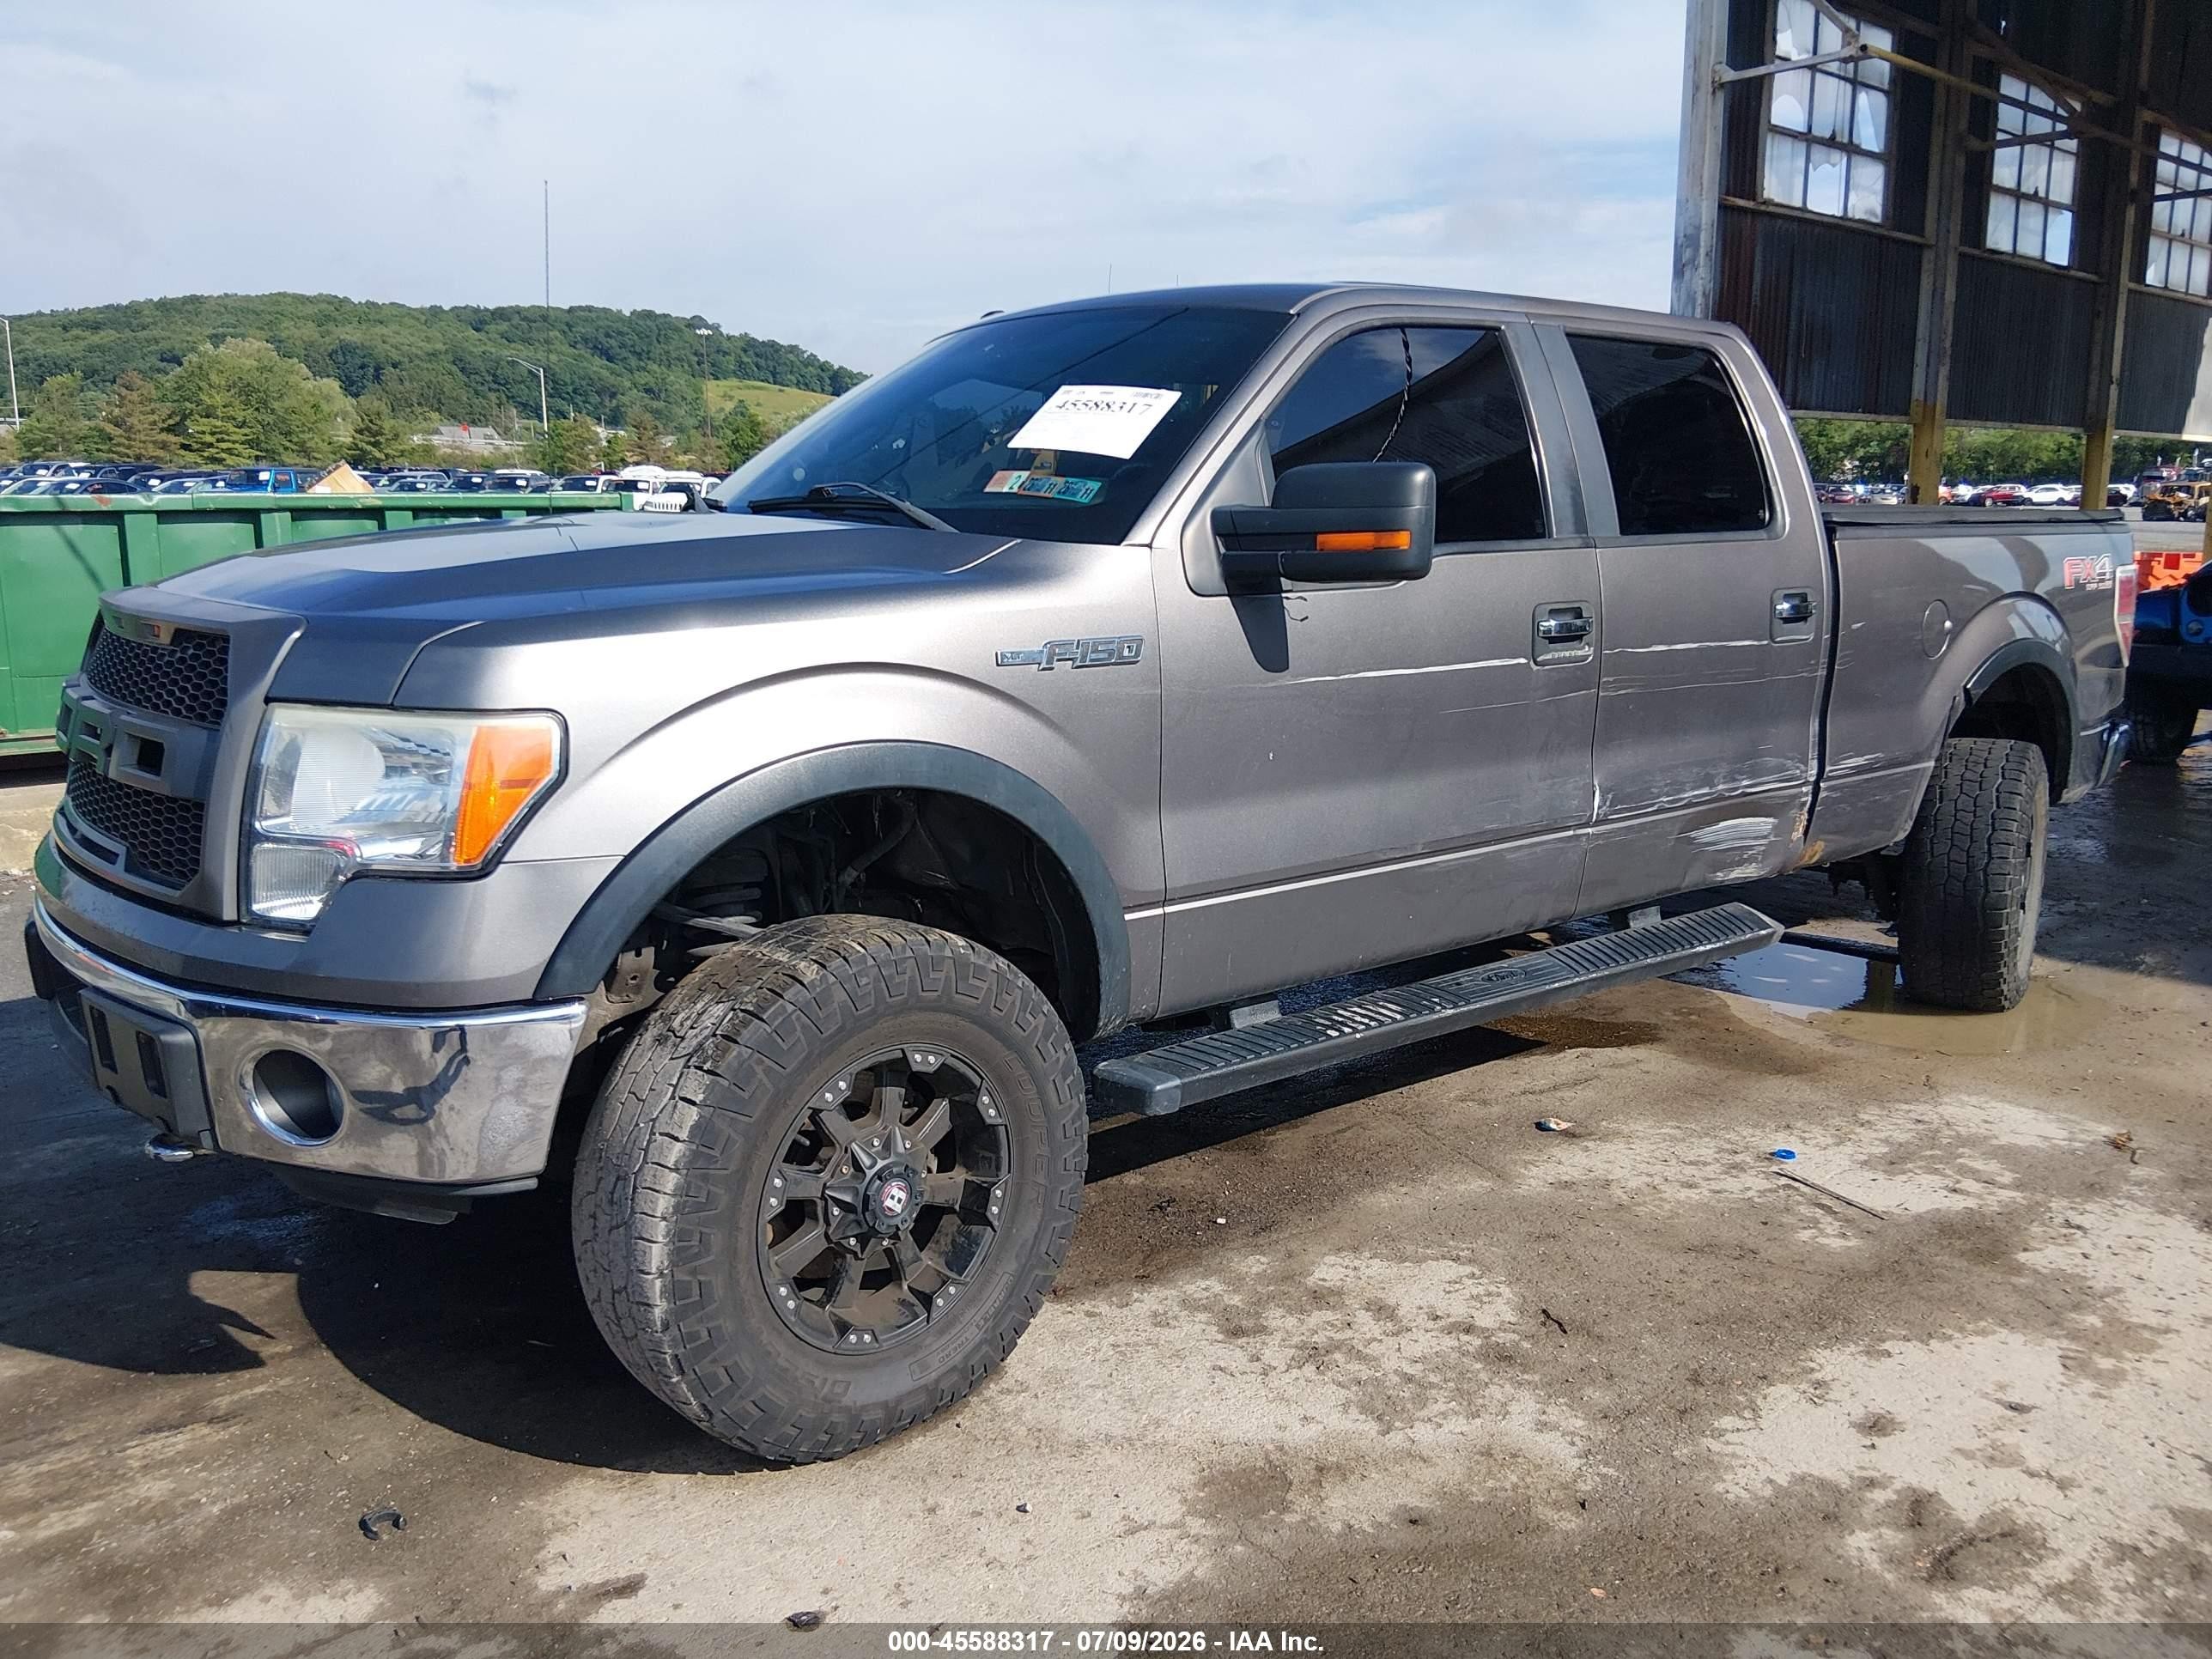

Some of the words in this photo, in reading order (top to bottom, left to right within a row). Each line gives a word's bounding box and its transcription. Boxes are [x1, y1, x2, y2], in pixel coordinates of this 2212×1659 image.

[1055, 398, 1152, 416] 45588317
[2063, 553, 2113, 590] FX4
[1037, 634, 1145, 672] F-150
[1003, 1050, 1050, 1212] COOPER
